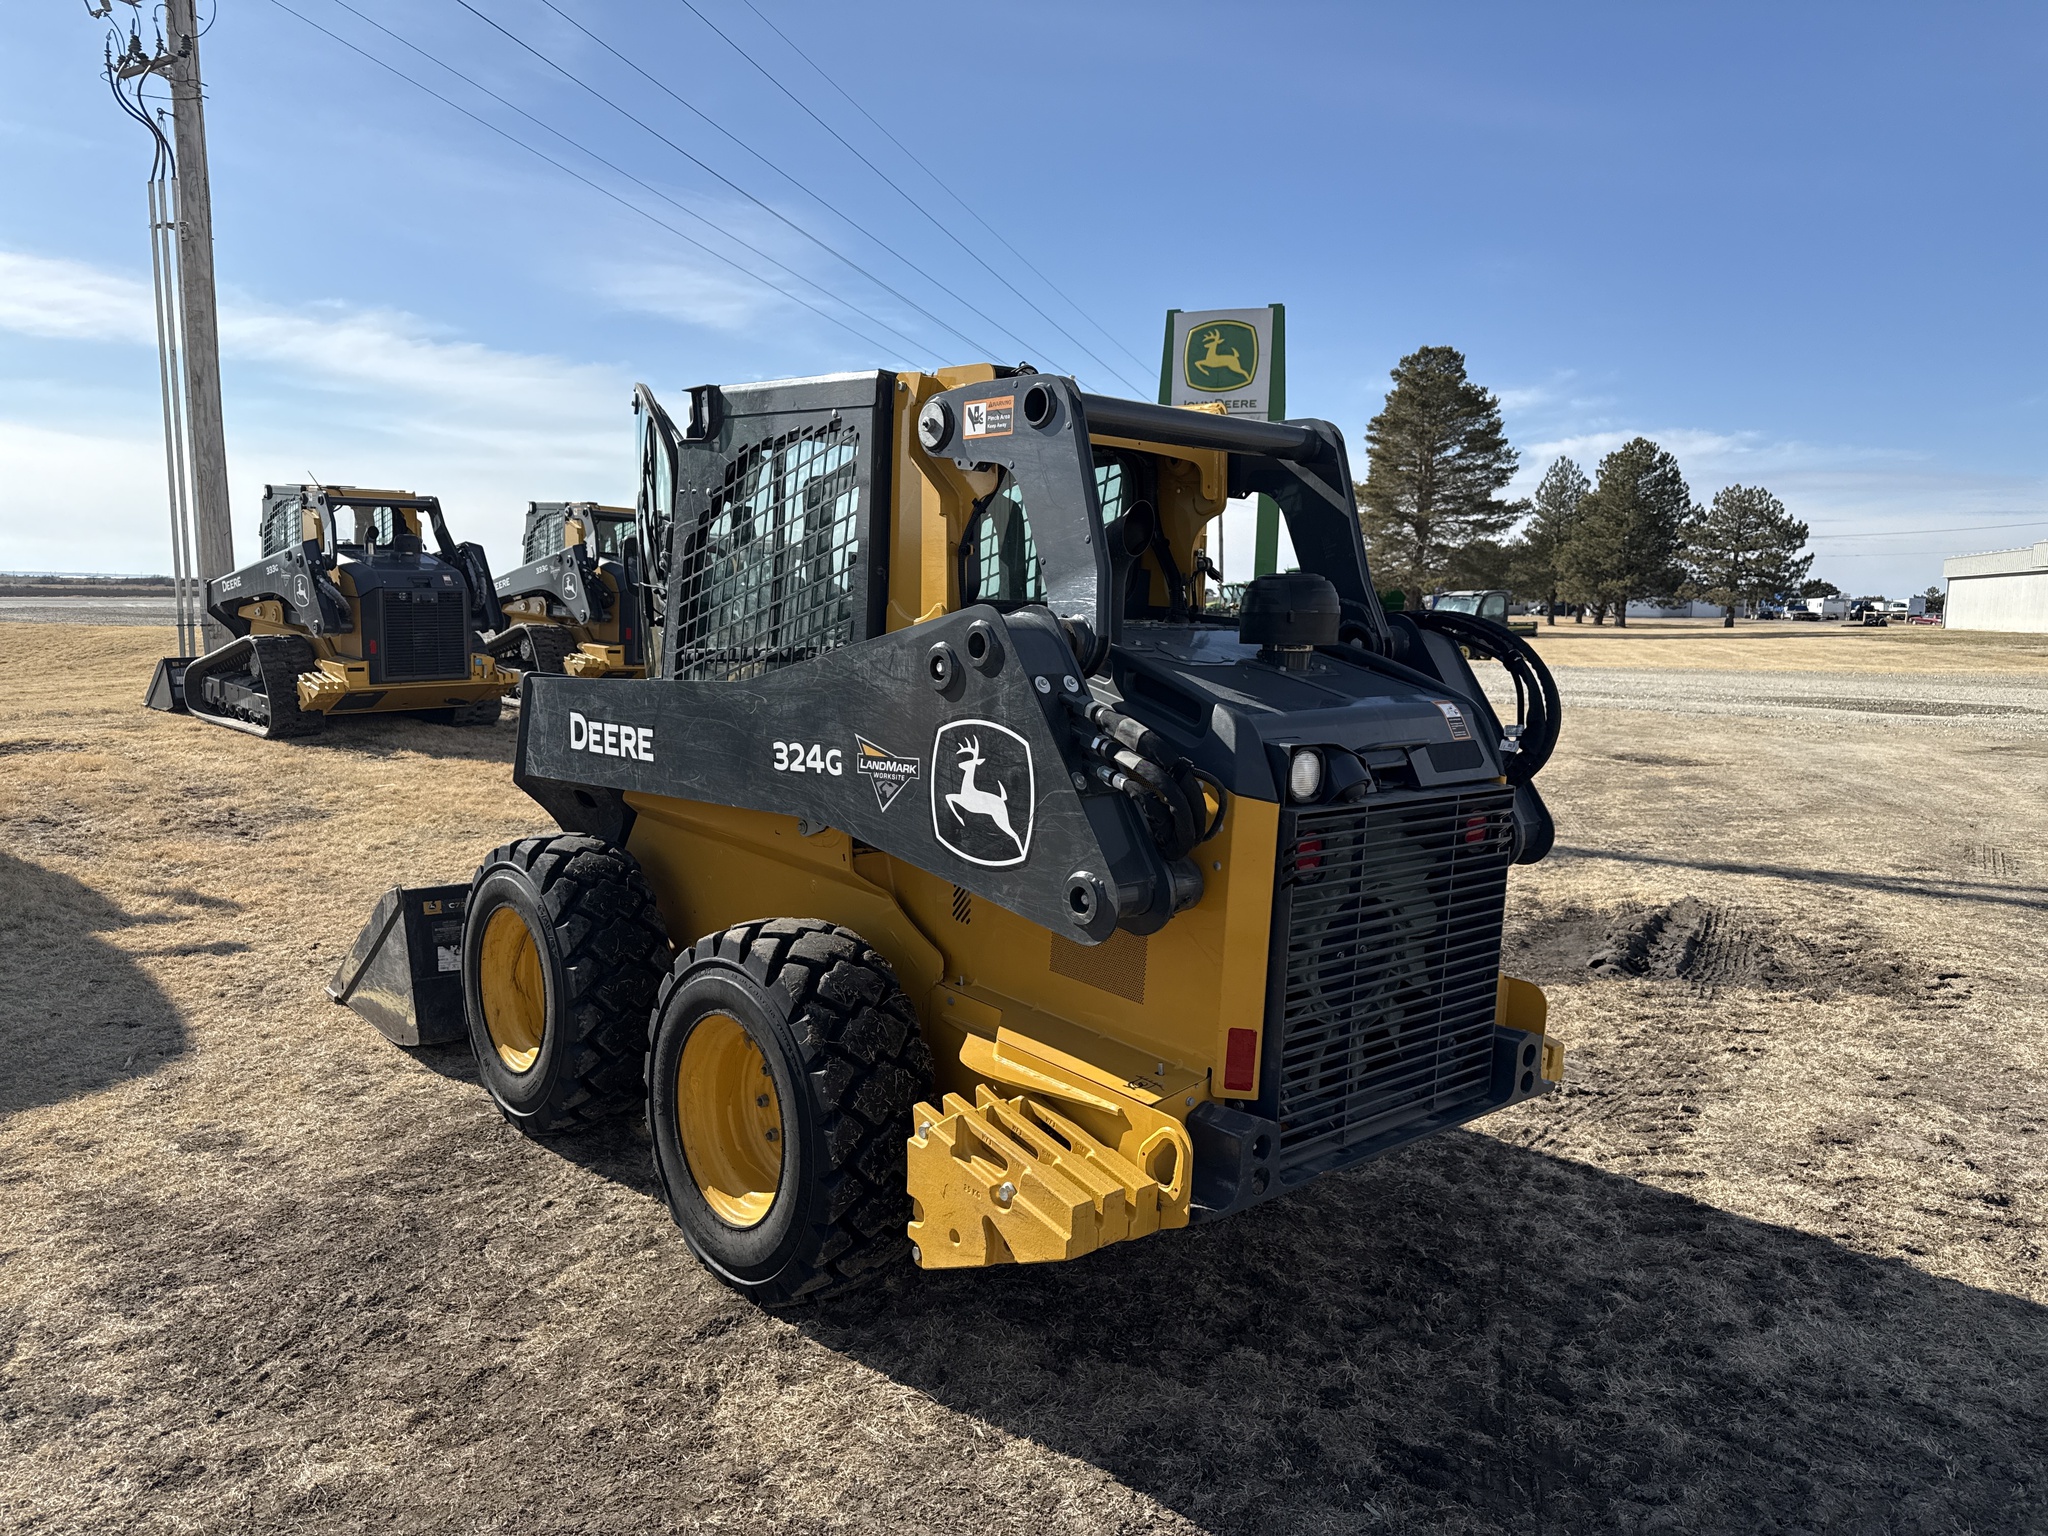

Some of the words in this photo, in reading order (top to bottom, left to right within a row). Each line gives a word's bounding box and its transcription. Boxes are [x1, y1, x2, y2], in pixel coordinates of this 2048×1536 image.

[266, 564, 278, 575] 333G
[222, 577, 242, 592] DEERE
[494, 577, 510, 591] EERE
[569, 711, 655, 762] DEERE
[772, 741, 843, 776] 324G
[860, 758, 917, 774] LANDMARK
[873, 771, 905, 781] WORKSITE
